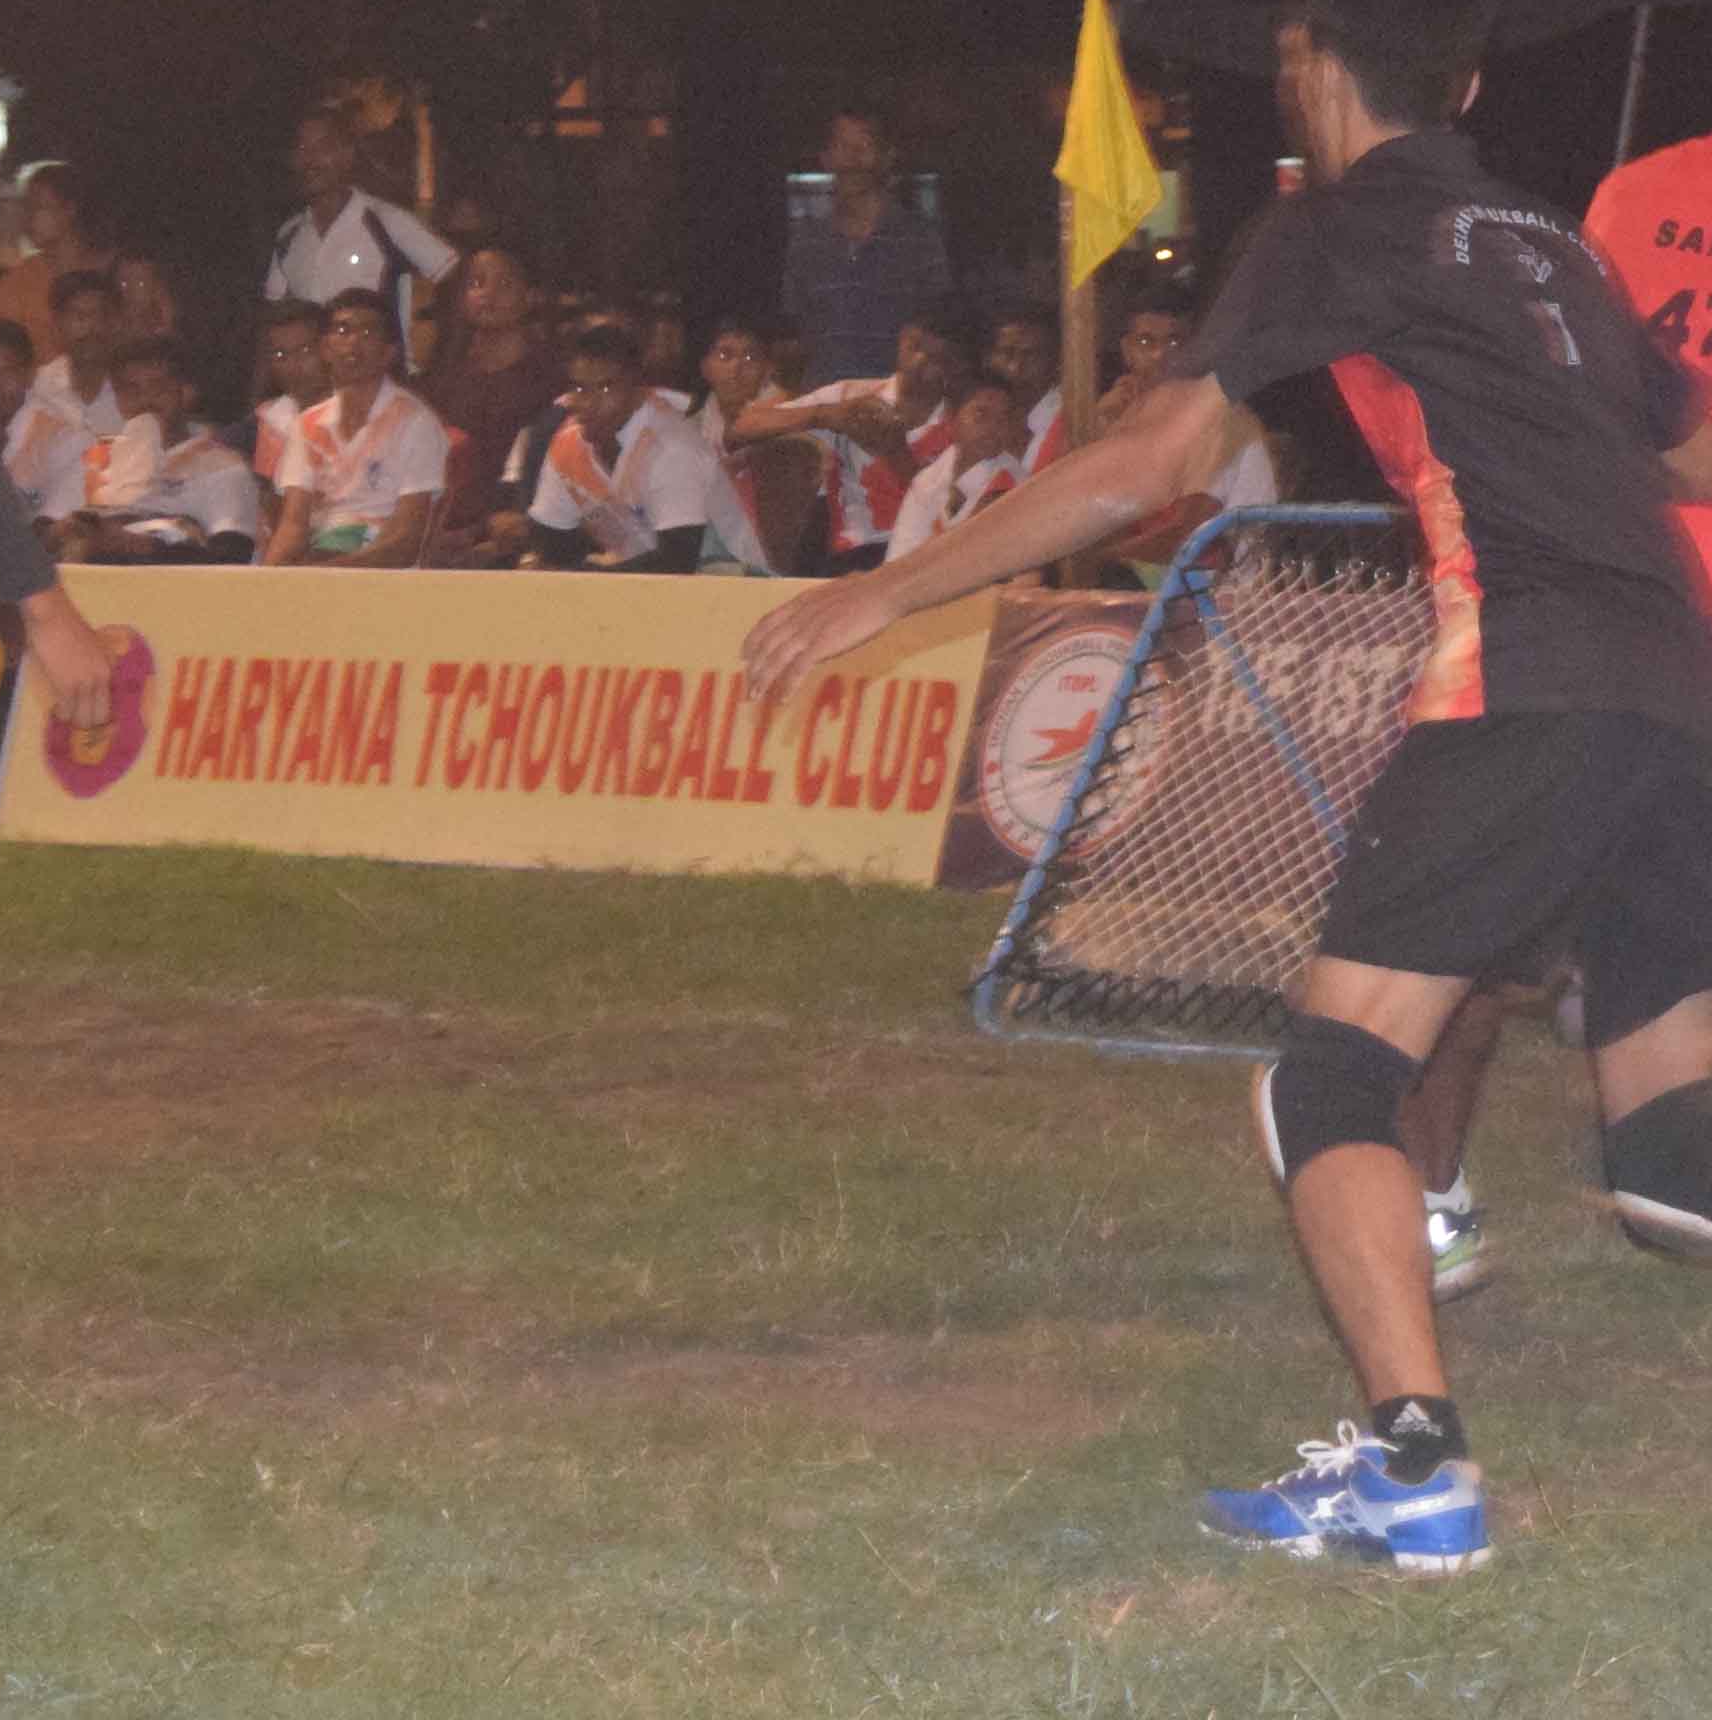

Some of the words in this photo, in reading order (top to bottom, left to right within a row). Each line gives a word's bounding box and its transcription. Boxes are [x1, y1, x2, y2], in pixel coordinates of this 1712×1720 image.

[154, 655, 406, 786] HARYANA
[414, 662, 778, 804] TCHOUKBALL
[792, 673, 959, 813] CLUB
